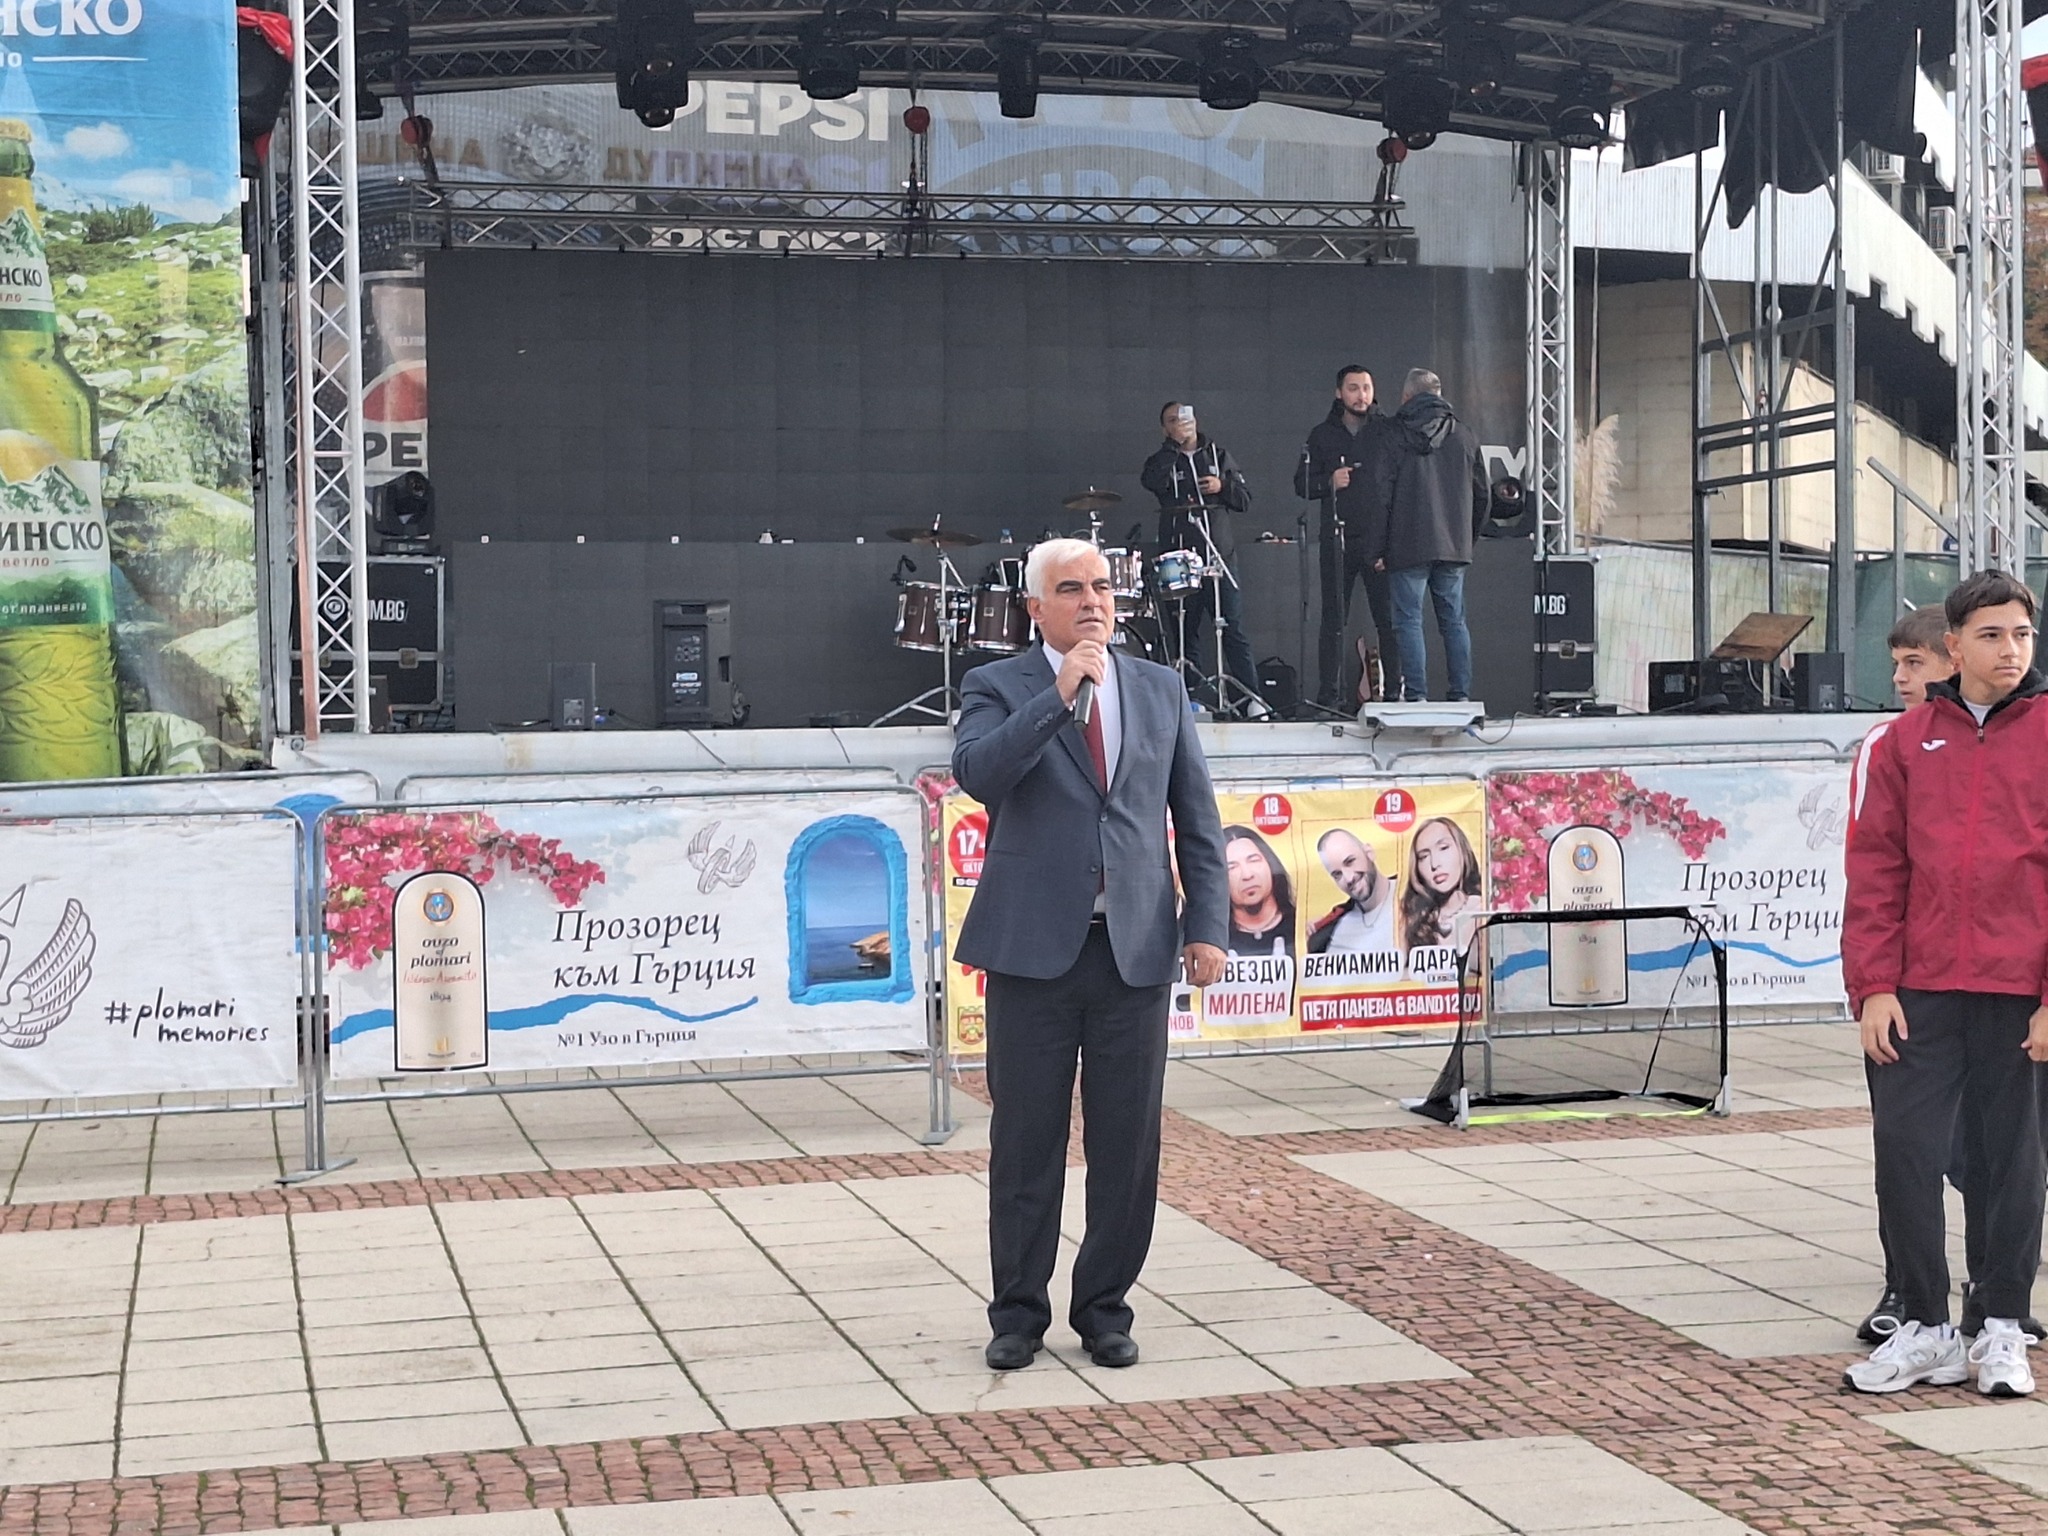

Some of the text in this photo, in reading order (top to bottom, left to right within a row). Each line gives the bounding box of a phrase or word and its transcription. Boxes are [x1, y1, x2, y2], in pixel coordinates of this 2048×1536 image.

[1263, 797, 1279, 816] 18
[1384, 793, 1402, 813] 19
[1680, 862, 1827, 901] Прозорец
[551, 909, 721, 953] Прозорец
[1748, 902, 1841, 941] Гърци
[410, 951, 472, 969] plomari
[1219, 960, 1287, 984] ВЕЗДИ
[1303, 951, 1400, 979] ВЕНИАМИН
[554, 952, 756, 994] към Гърция
[1752, 972, 1806, 989] Гърция
[104, 986, 236, 1038] #plomari
[1208, 992, 1286, 1015] МИЛЕНА
[1302, 1000, 1338, 1022] ПЕТЯ
[1339, 996, 1394, 1020] ПАНЕВА
[1406, 994, 1443, 1016] BAND
[158, 1023, 269, 1043] memories
[589, 1031, 618, 1047] Узо
[635, 1029, 697, 1047] Гърция
